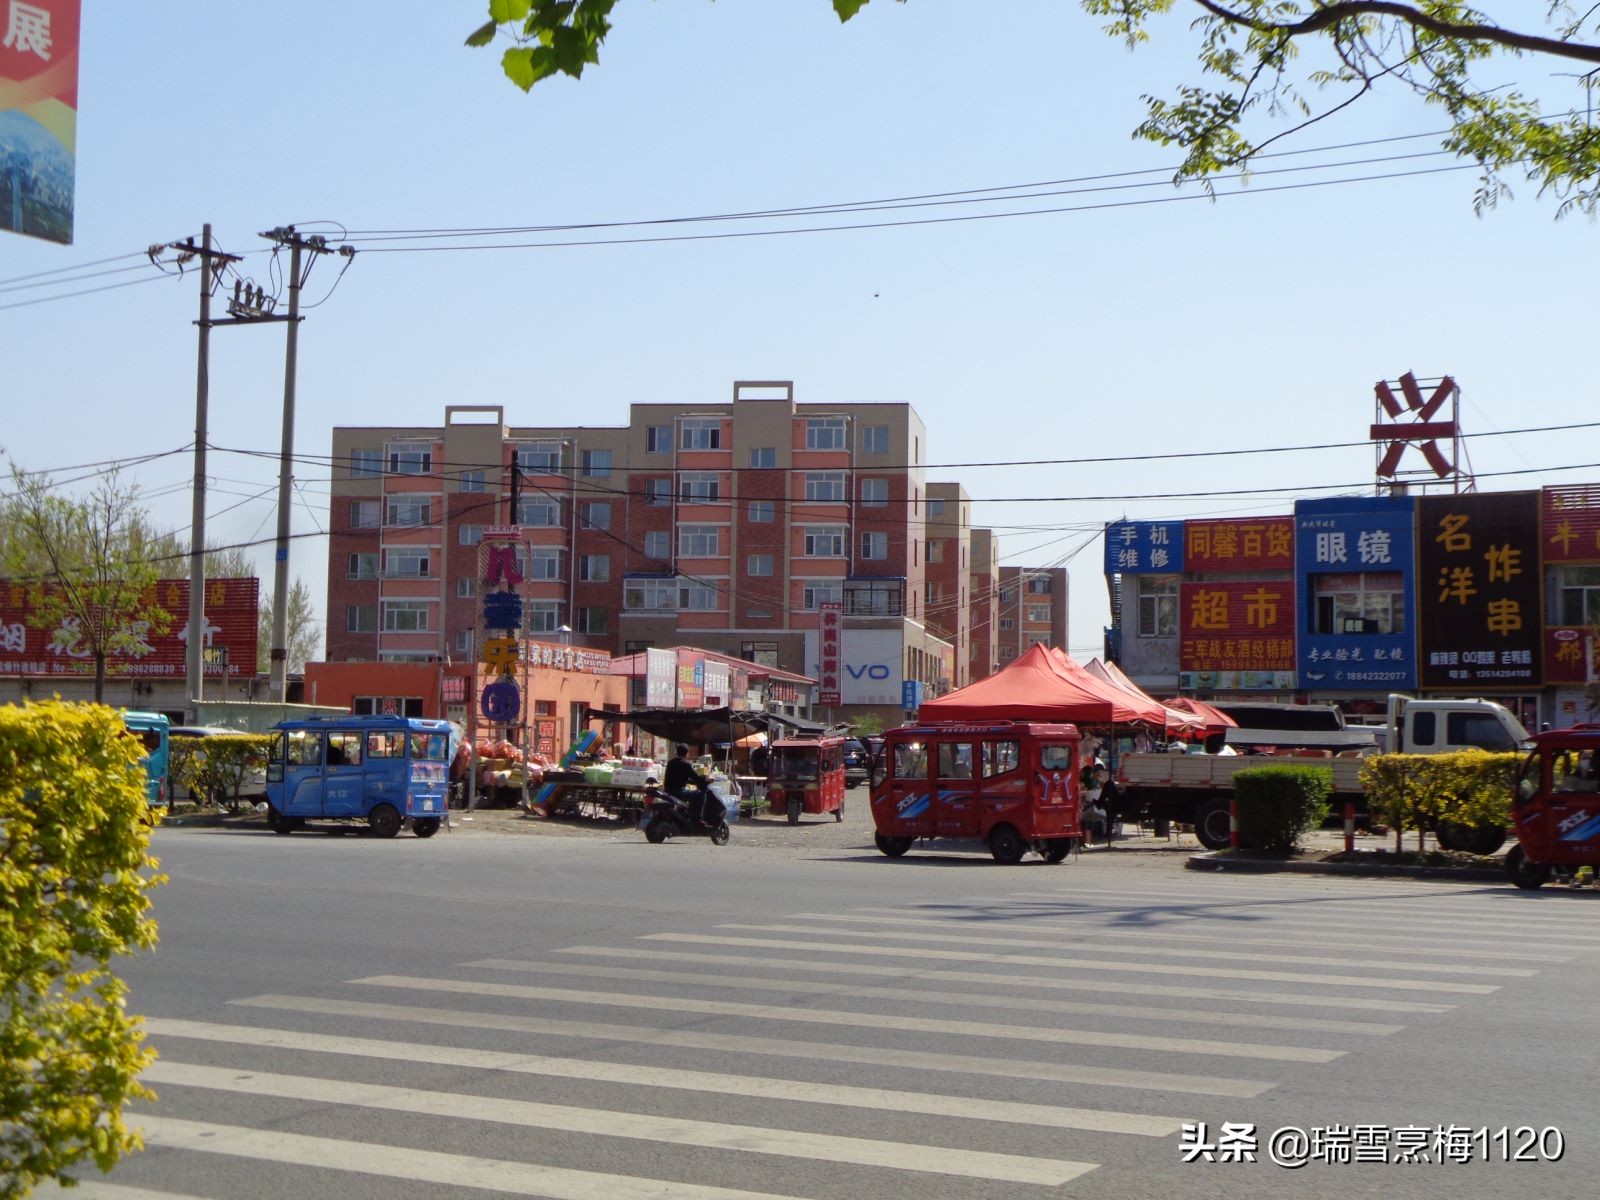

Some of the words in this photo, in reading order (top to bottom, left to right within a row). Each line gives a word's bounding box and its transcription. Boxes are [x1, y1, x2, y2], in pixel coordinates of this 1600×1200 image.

[3, 1, 52, 62] 展
[1119, 526, 1169, 546] 手机
[1187, 523, 1293, 561] 同馨百货
[1316, 529, 1391, 565] 眼镜
[1118, 549, 1169, 568] 维修
[1190, 588, 1282, 630] 超市
